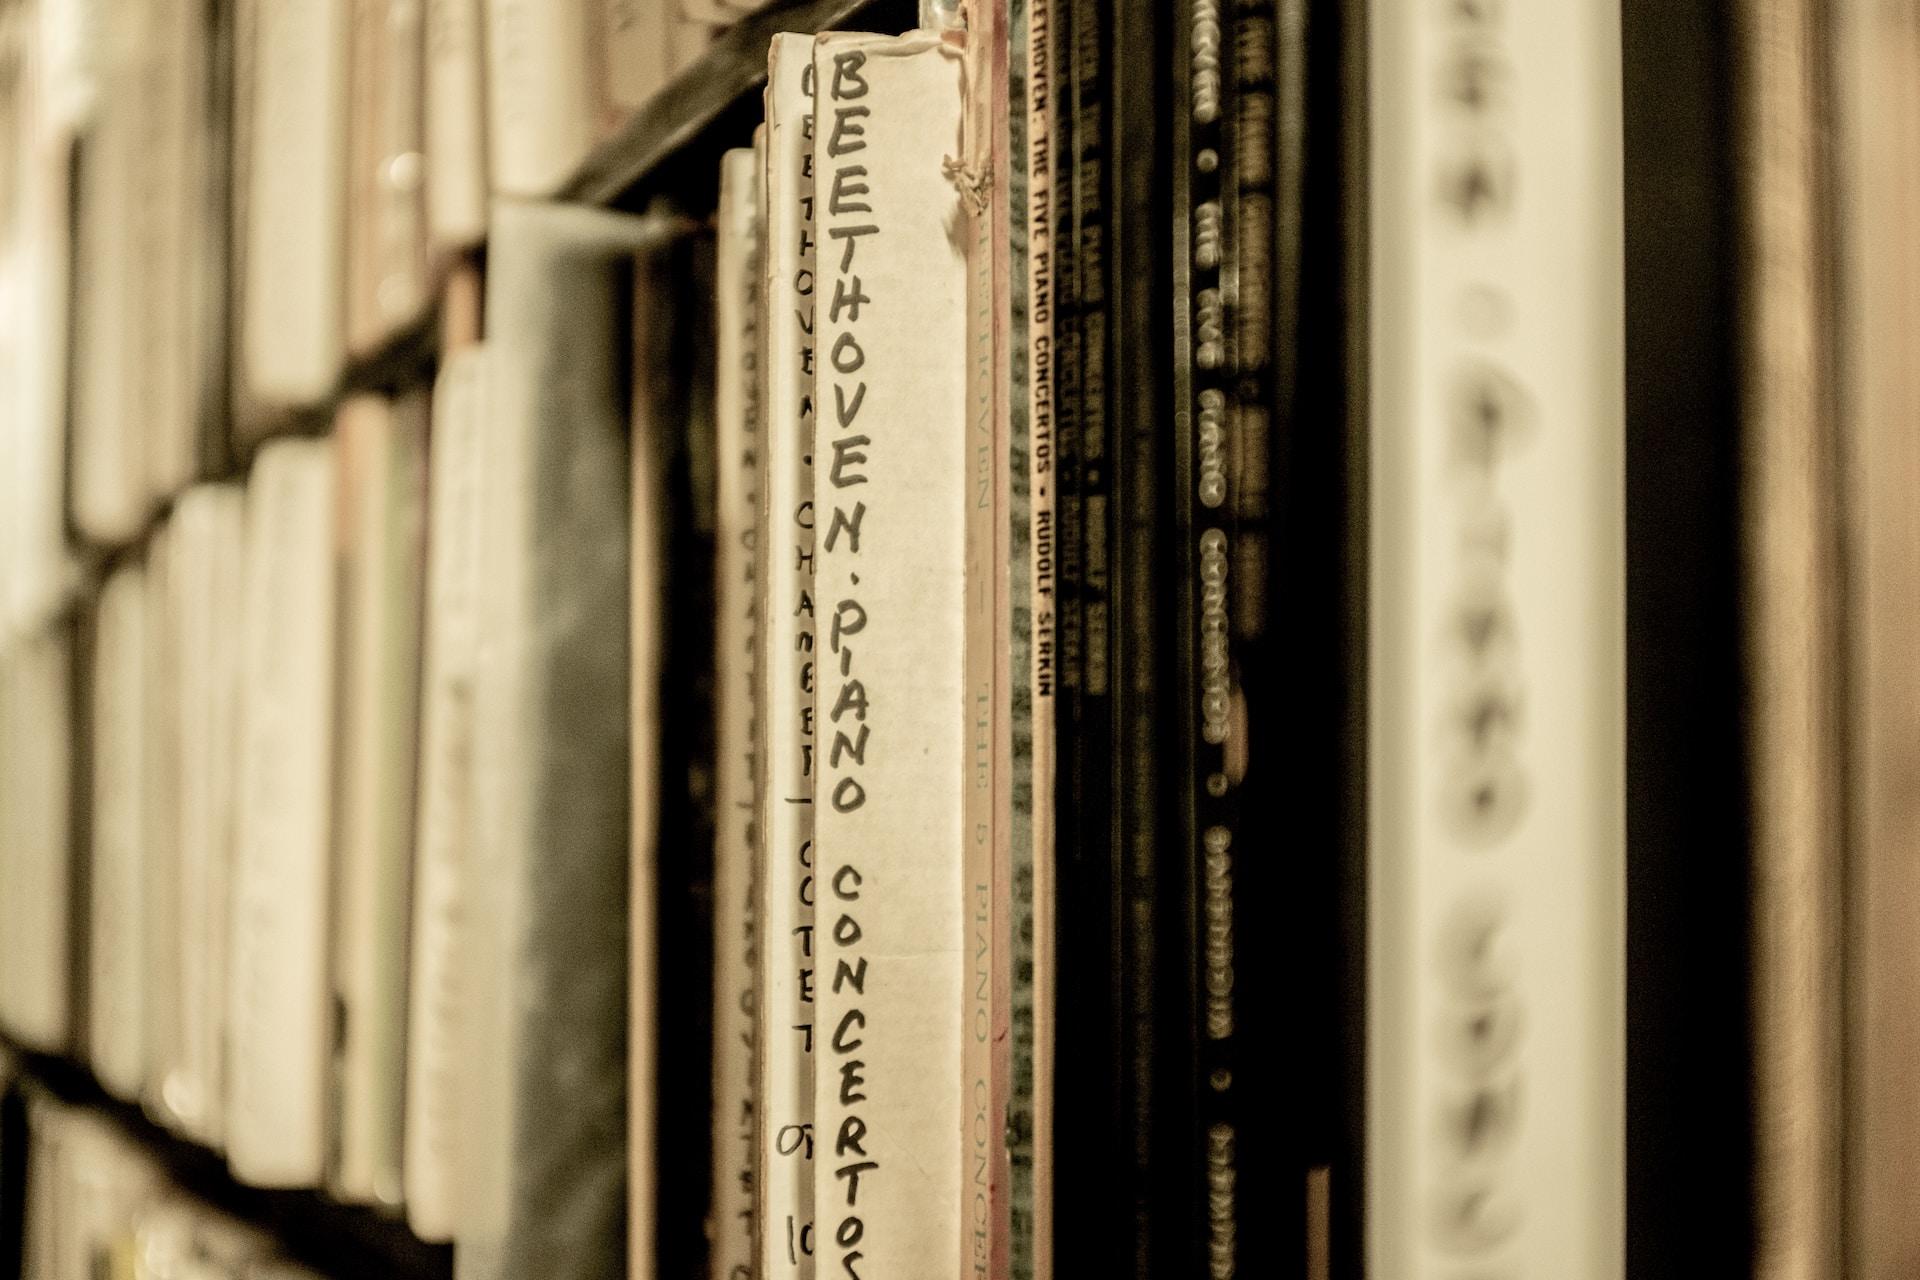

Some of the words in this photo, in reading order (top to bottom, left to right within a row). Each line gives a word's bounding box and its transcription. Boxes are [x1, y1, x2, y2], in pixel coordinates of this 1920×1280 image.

[1033, 133, 1049, 178] THE
[1033, 189, 1049, 241] FIVE
[824, 50, 880, 552] BEETHOVEN
[1034, 251, 1050, 325] PIANO
[1035, 334, 1051, 475] CONCERTOS
[1037, 511, 1052, 596] RUDOLF
[1038, 610, 1052, 697] SERKIN
[830, 599, 870, 814] PIANO
[975, 683, 989, 790] THE
[976, 822, 989, 846] 5
[974, 882, 989, 1043] PIANO
